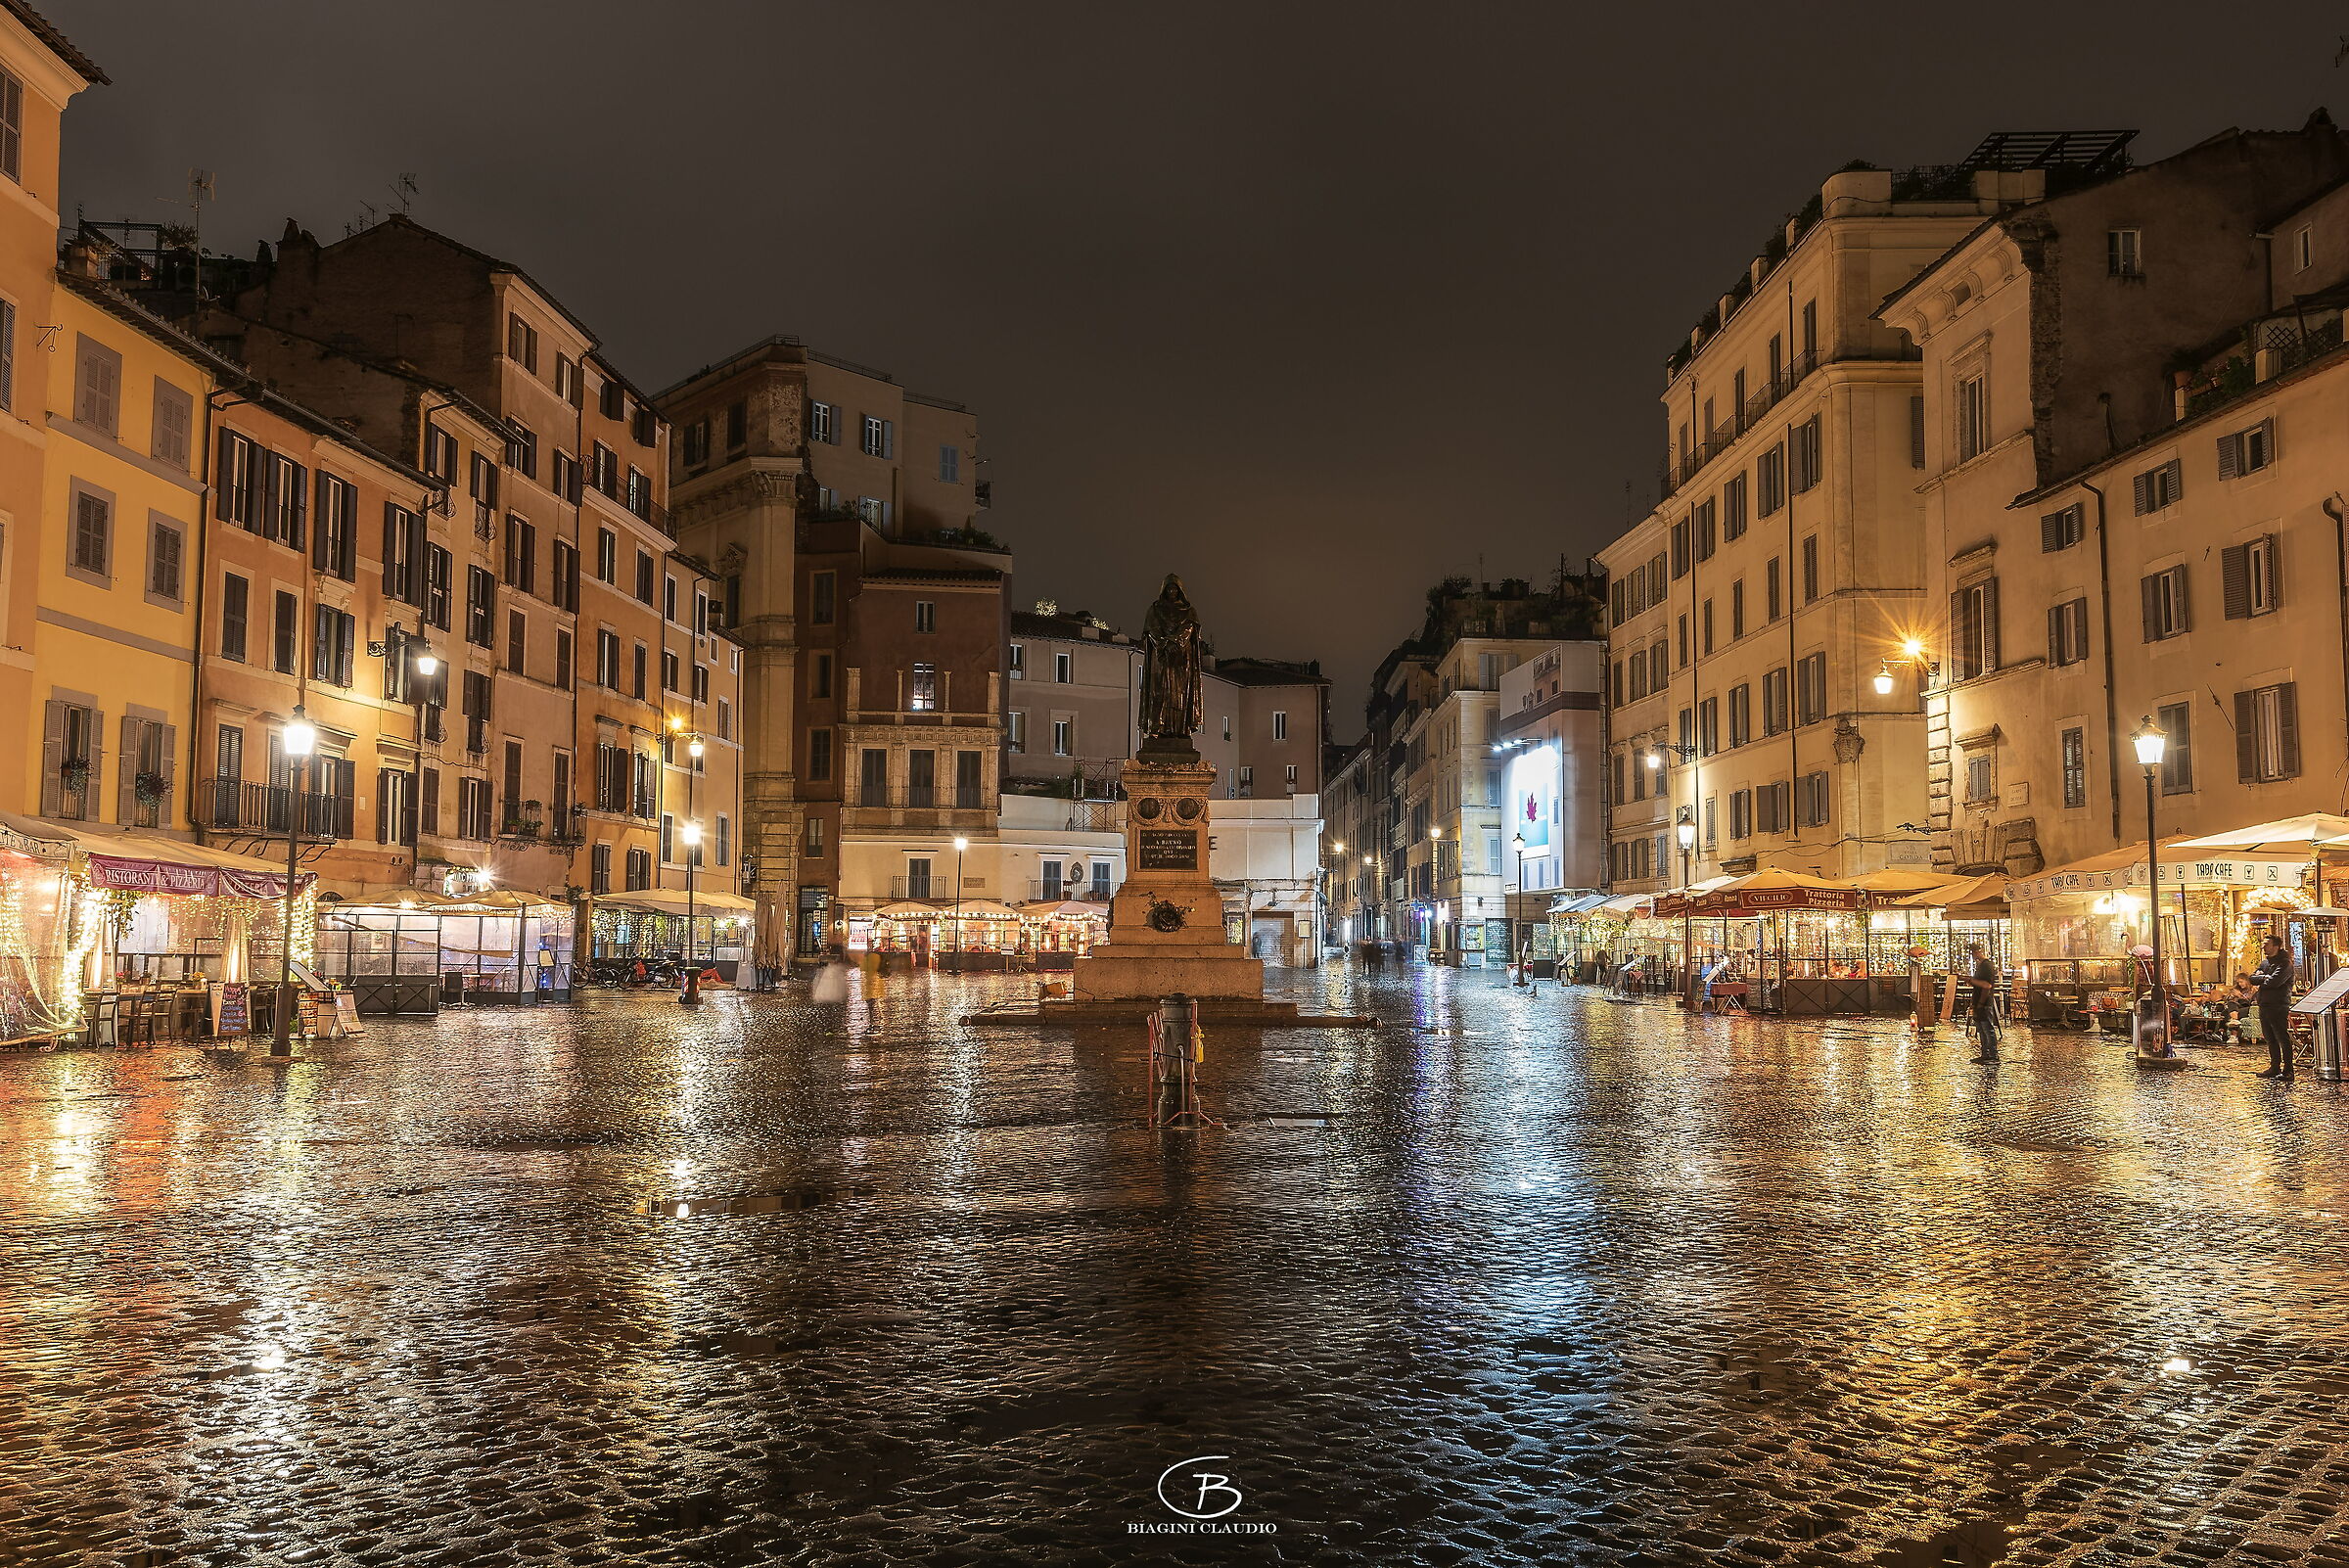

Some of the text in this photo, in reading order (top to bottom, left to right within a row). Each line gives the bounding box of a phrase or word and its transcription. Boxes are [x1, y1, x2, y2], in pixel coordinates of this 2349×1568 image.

[161, 874, 169, 886] &
[1804, 889, 1845, 899] Trattoria
[1808, 898, 1845, 907] Pizzeria
